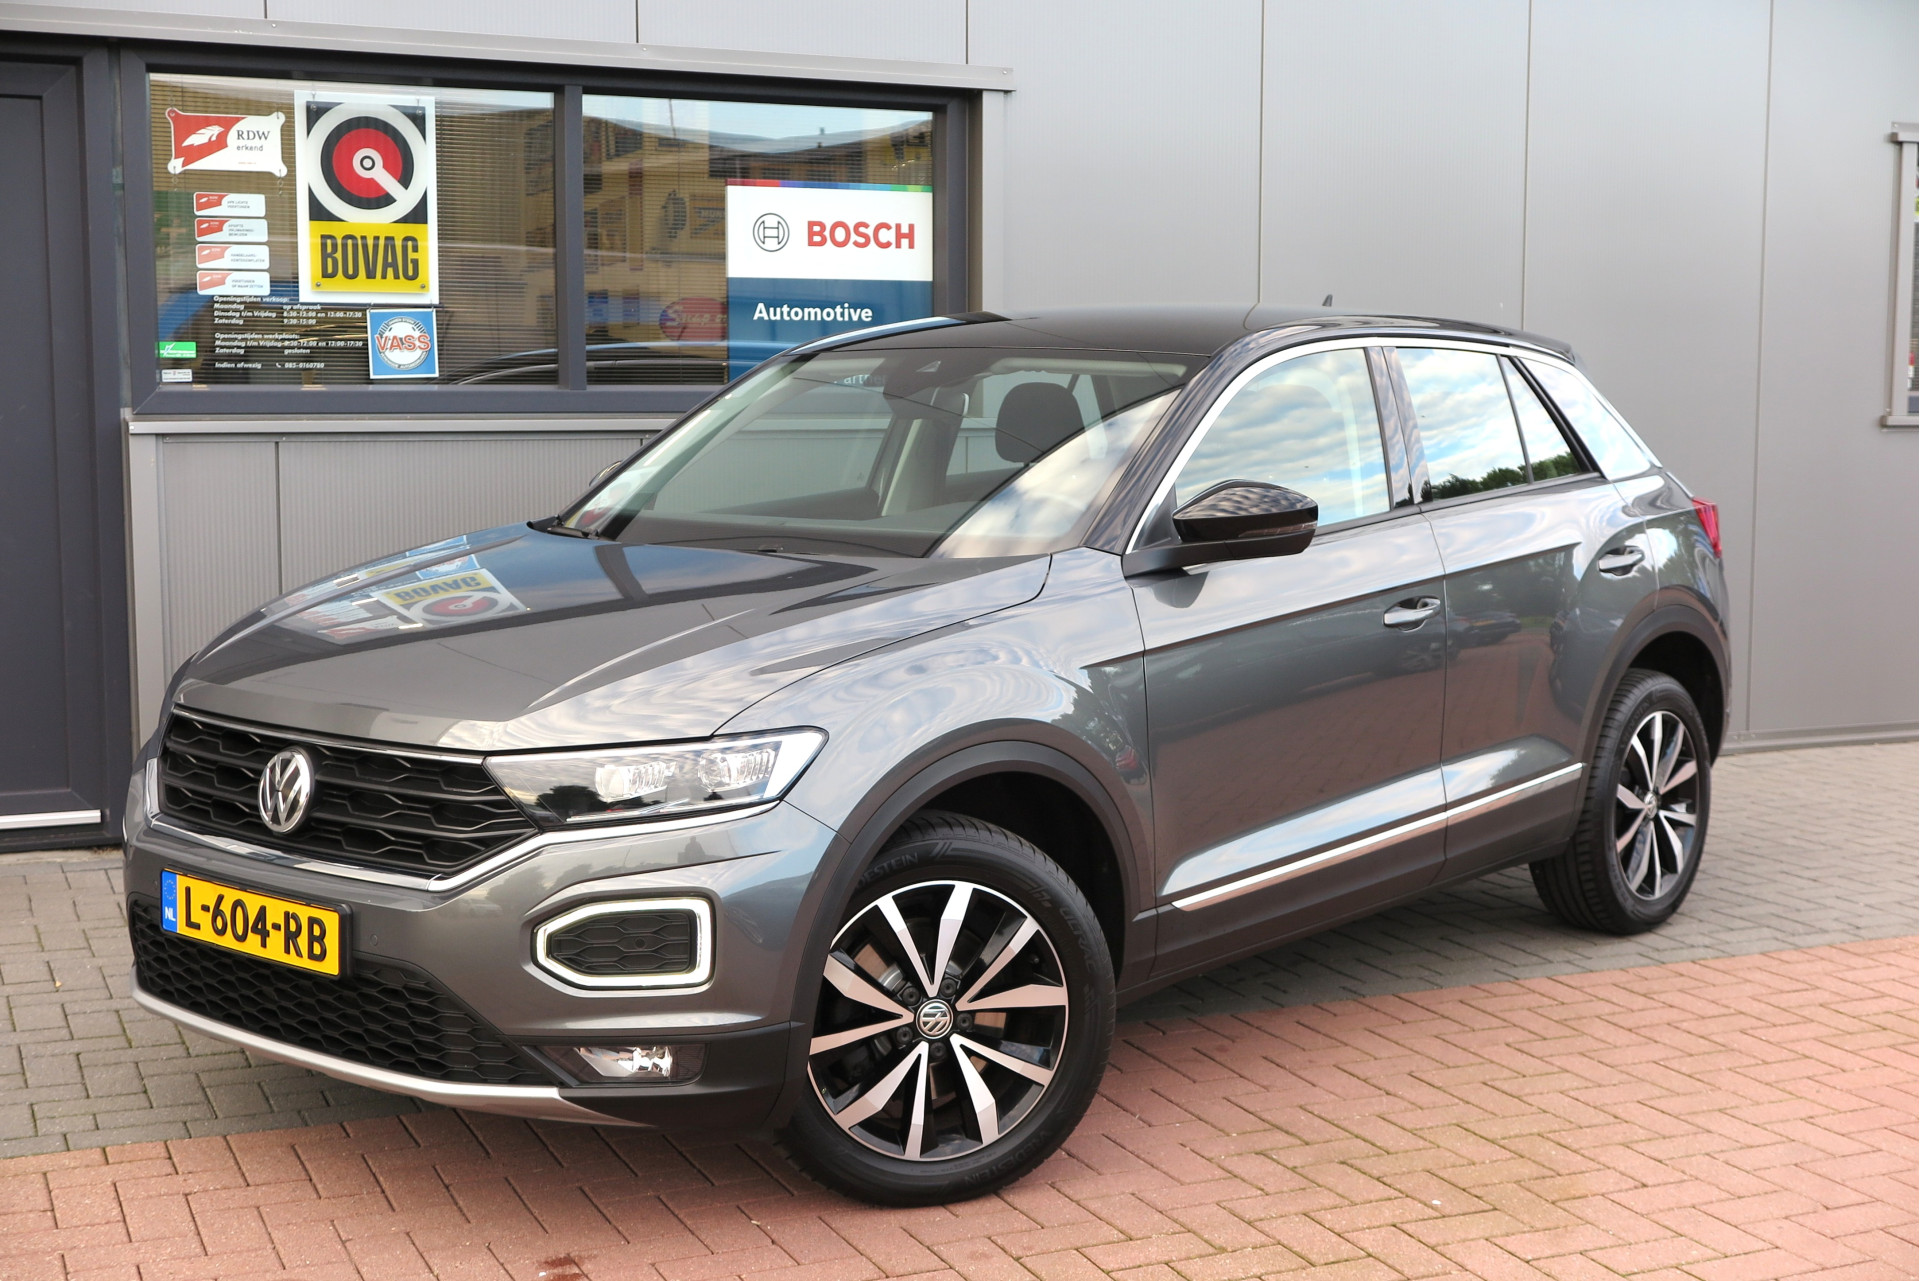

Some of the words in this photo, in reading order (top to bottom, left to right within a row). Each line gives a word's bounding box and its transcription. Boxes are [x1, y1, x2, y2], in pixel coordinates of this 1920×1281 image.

[236, 130, 270, 140] RDW
[236, 144, 264, 152] erkend
[807, 220, 915, 249] BOSCH
[320, 234, 419, 281] BOVAG
[213, 295, 261, 303] Openingstijden
[752, 302, 873, 322] Automotive
[214, 332, 262, 340] Openingstijden
[375, 334, 431, 351] VASS
[164, 906, 176, 921] NL
[184, 886, 328, 962] L-604-RB
